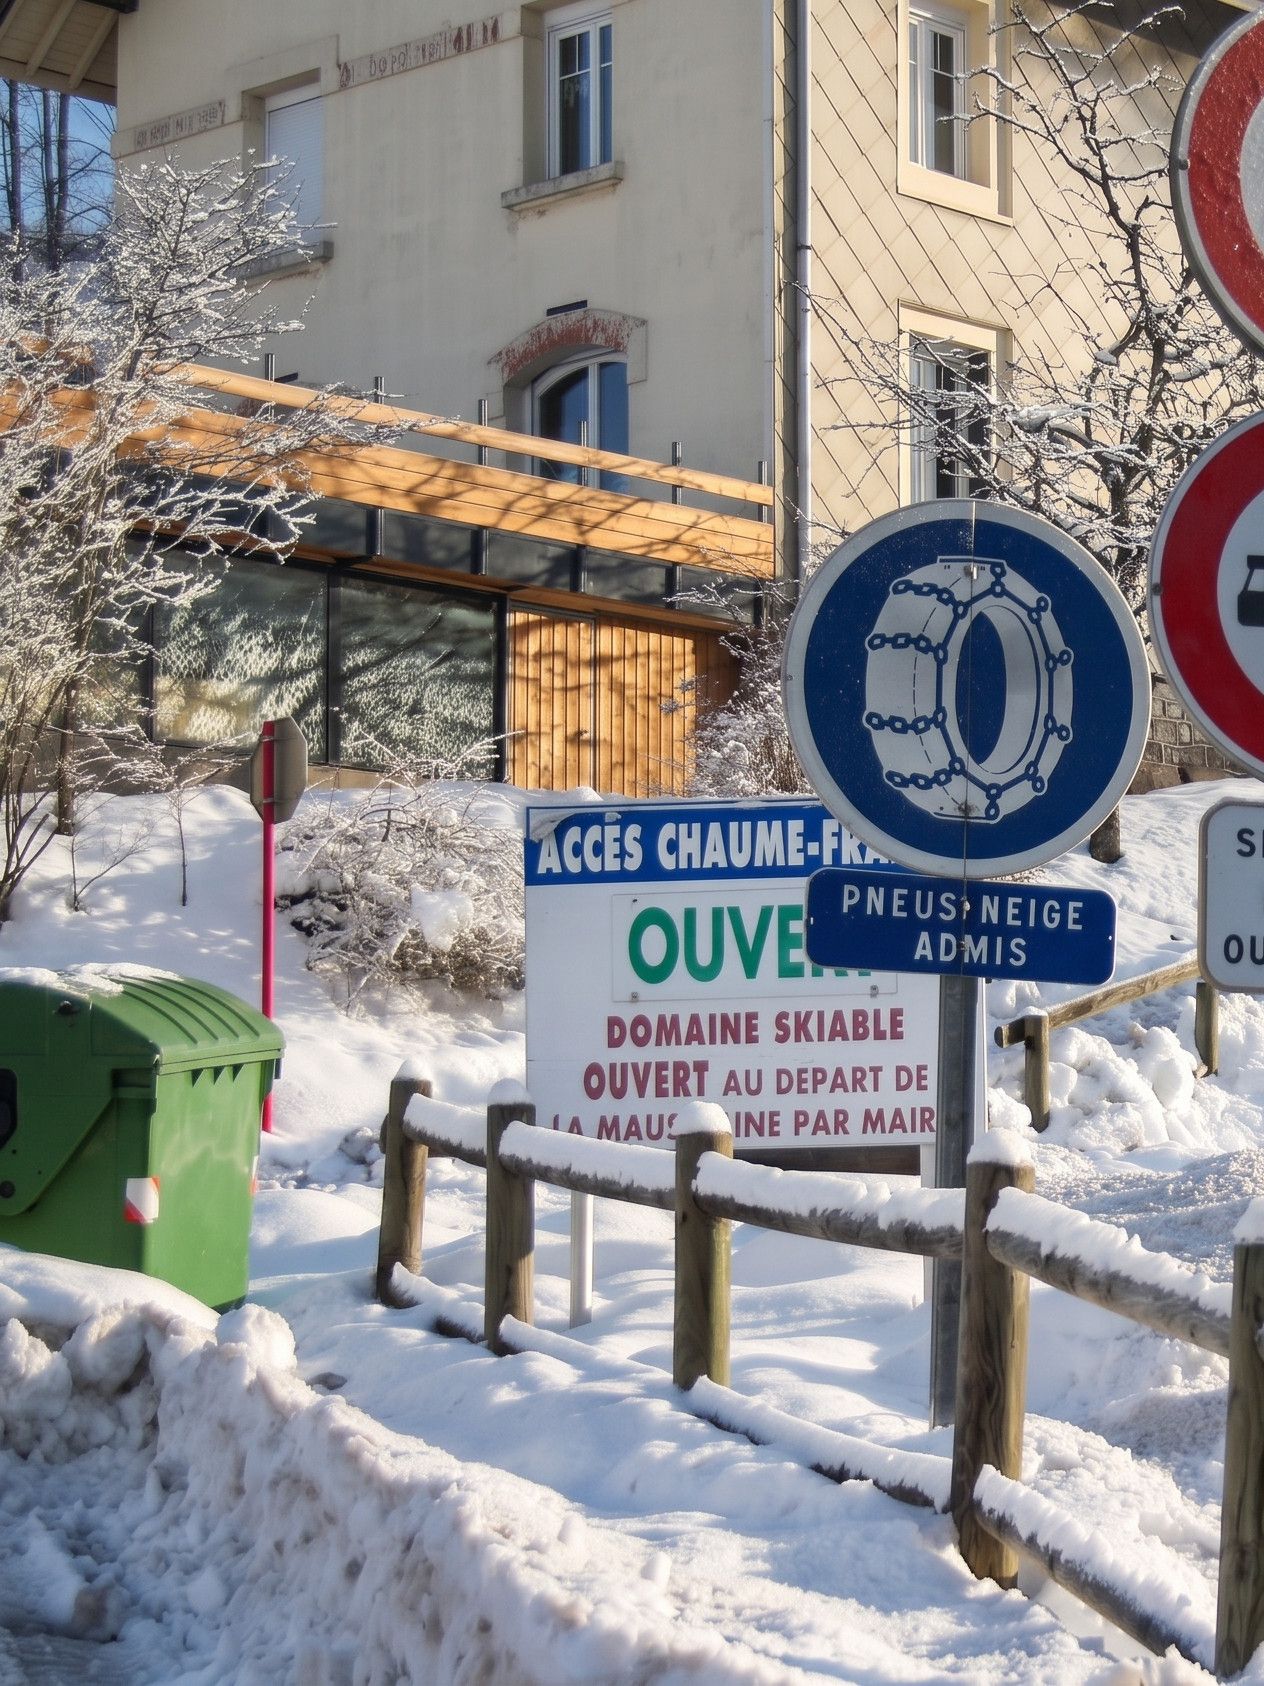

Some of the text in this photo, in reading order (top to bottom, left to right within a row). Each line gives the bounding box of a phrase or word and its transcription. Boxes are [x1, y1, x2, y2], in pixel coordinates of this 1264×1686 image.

[842, 884, 1083, 930] PNEUS NEIGE
[628, 904, 871, 985] OUVE
[914, 931, 1027, 966] ADMIS
[607, 1008, 904, 1048] DOMAINE SKIABLE
[583, 1060, 929, 1100] OUVERT AU DEPART DE
[794, 1109, 850, 1136] PAR
